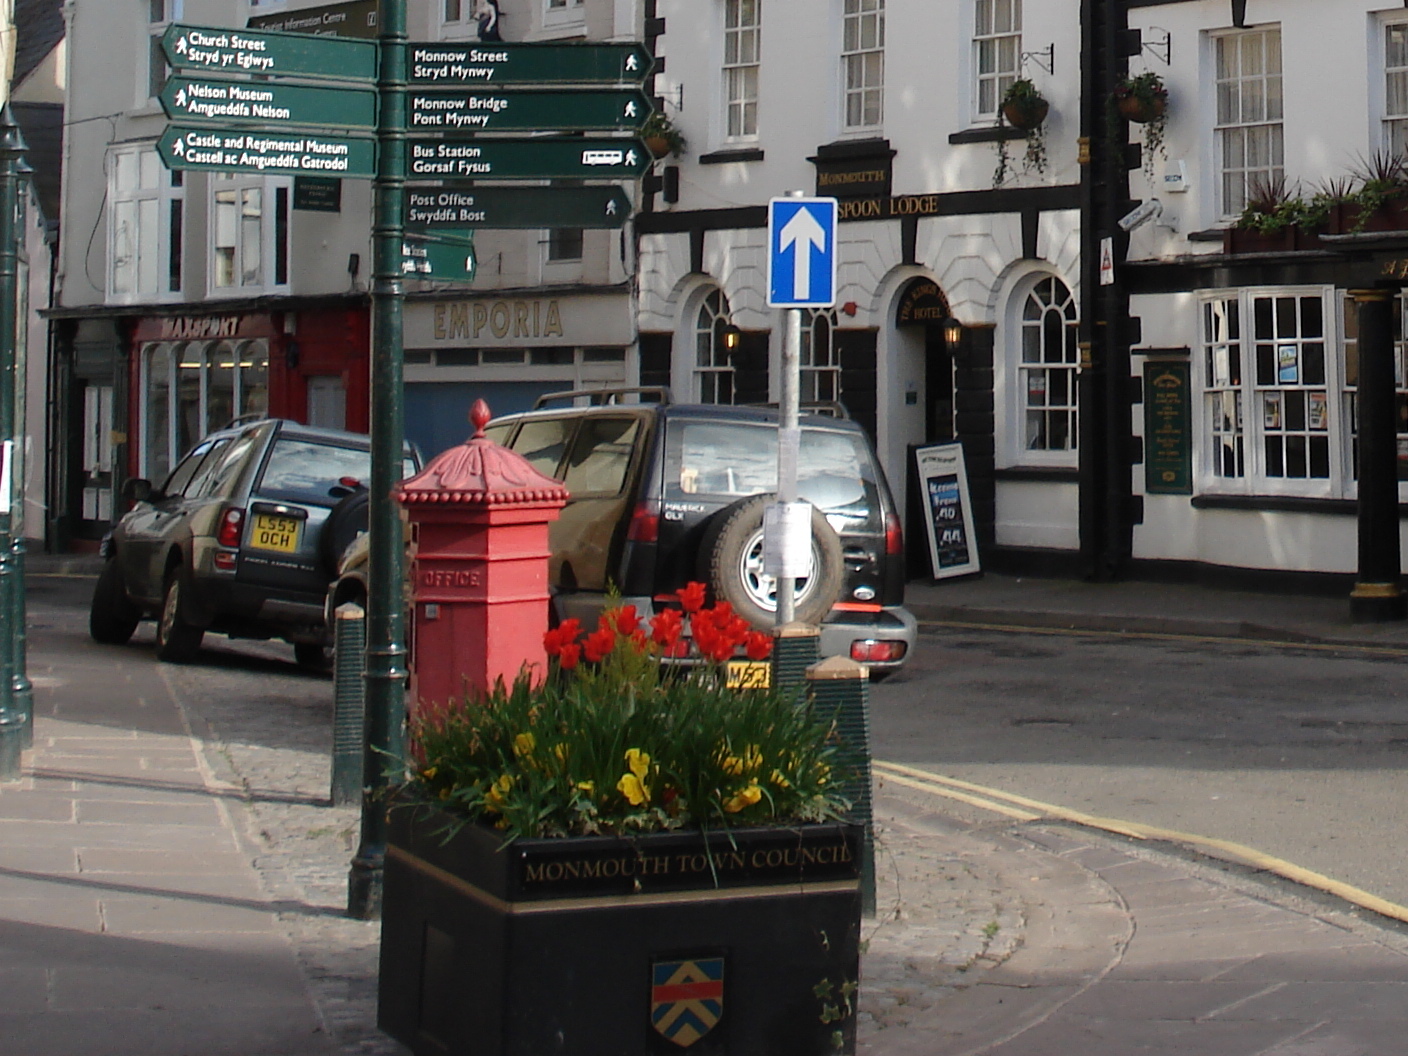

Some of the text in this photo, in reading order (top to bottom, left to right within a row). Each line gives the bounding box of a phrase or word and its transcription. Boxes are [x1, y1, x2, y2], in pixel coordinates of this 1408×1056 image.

[323, 13, 346, 25] Centre
[189, 32, 266, 51] Church Street
[188, 47, 274, 71] Stryd yr Eglwys
[414, 49, 508, 62] Monnow Street
[414, 65, 494, 80] Stryd Mynwy
[188, 84, 273, 102] Nelson Museum
[188, 101, 290, 119] Amgueddfa Nelson
[413, 97, 508, 112] Monnow Bridge
[413, 113, 489, 127] Pont Mynwy
[186, 133, 348, 155] Castle and Regimental Museum
[413, 145, 481, 158] Bus Station
[186, 149, 348, 170] Castell ac Amgueddfa Gatrodol
[413, 160, 491, 176] Gorsaf Fysus
[818, 170, 885, 186] MONMOUTH
[410, 194, 474, 206] Post Office
[890, 196, 938, 215] LODGE
[409, 209, 486, 224] Swyddfa Bost
[434, 300, 563, 340] EMPORIA
[258, 514, 296, 533] LS53
[260, 532, 289, 547] OCH
[425, 570, 481, 587] OFFICE
[526, 845, 852, 882] MONMOUTH TOWN COUNCIL
